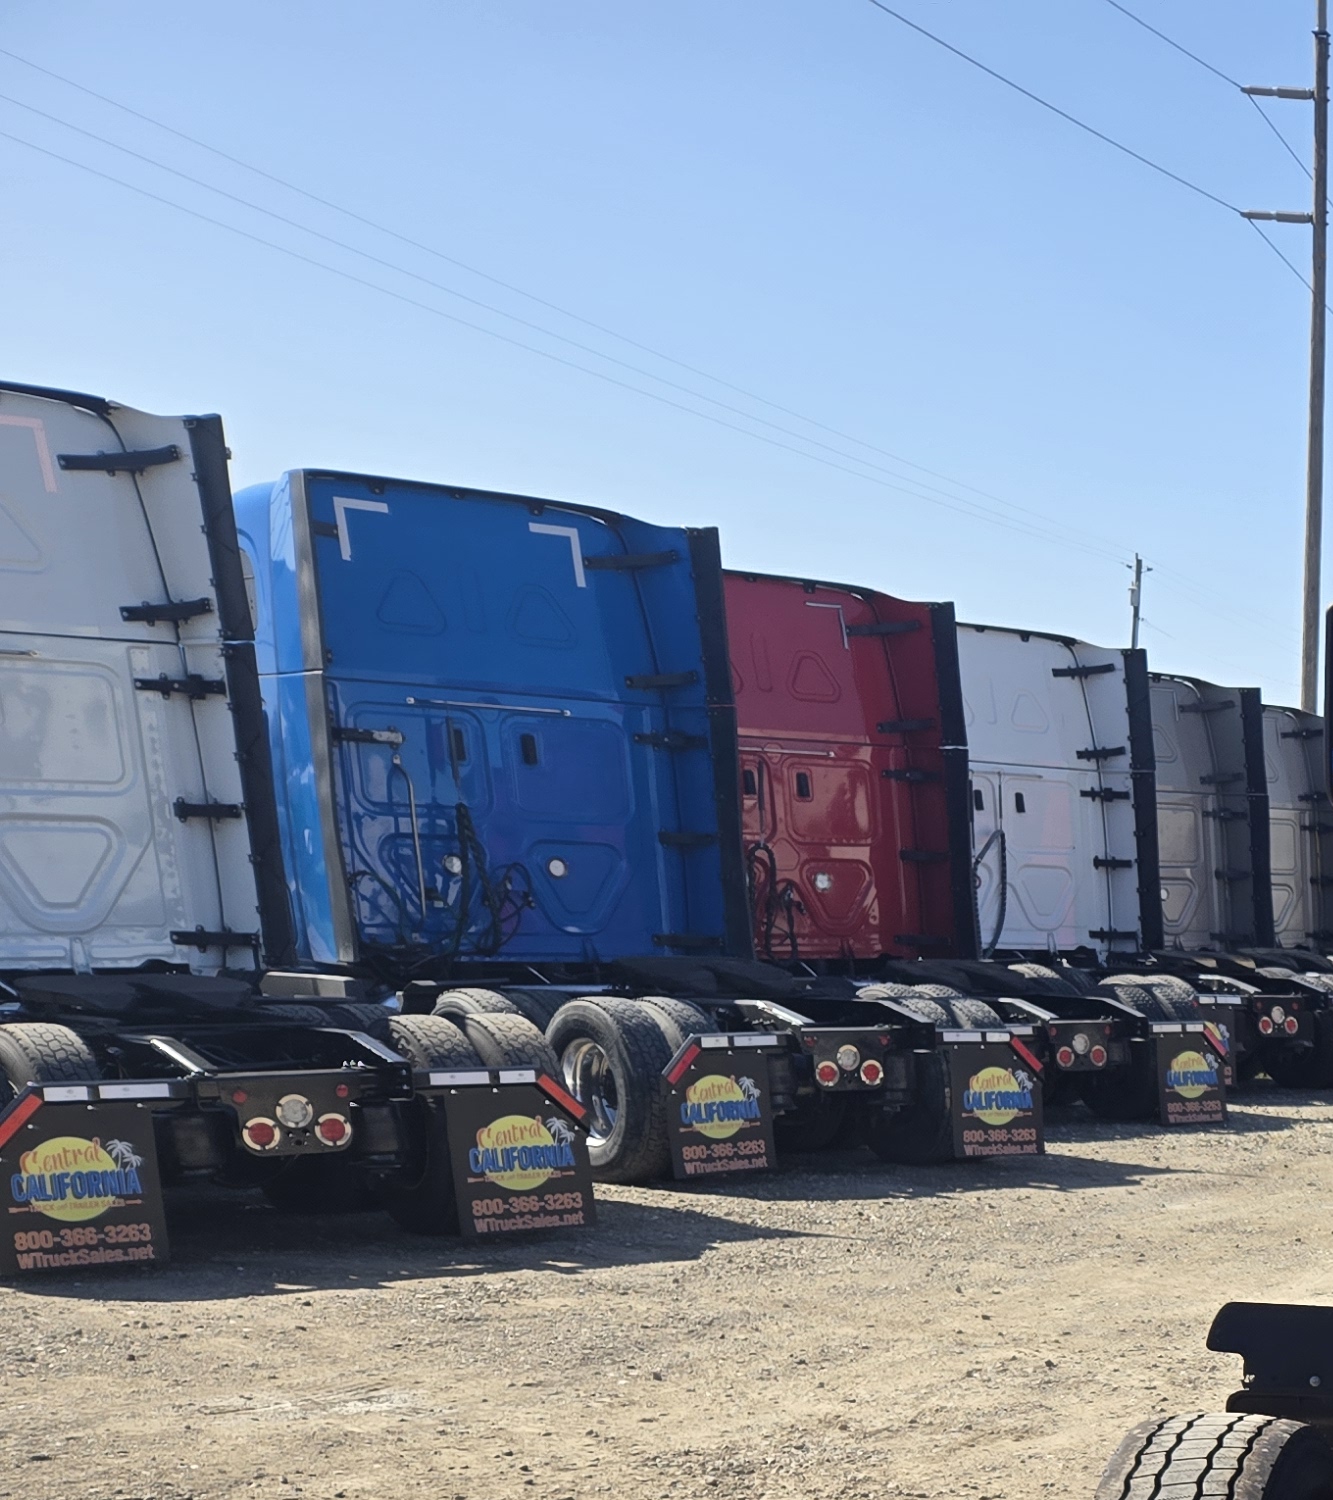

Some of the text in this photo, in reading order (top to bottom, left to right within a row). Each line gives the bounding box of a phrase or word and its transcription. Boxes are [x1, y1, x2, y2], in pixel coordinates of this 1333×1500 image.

[686, 1074, 737, 1103] Central
[681, 1098, 761, 1125] CALIFORNIA
[476, 1115, 543, 1148] Central
[20, 1137, 102, 1175] Central
[469, 1142, 576, 1173] CALIFORNIA
[682, 1140, 765, 1160] 800-366-3263
[10, 1168, 142, 1202] CALIFORNIA
[472, 1192, 583, 1216] 800-366-3263
[474, 1210, 584, 1233] WTruckSales.net
[14, 1223, 151, 1251] 800-366-3263
[16, 1243, 155, 1270] WTruckSales.net
